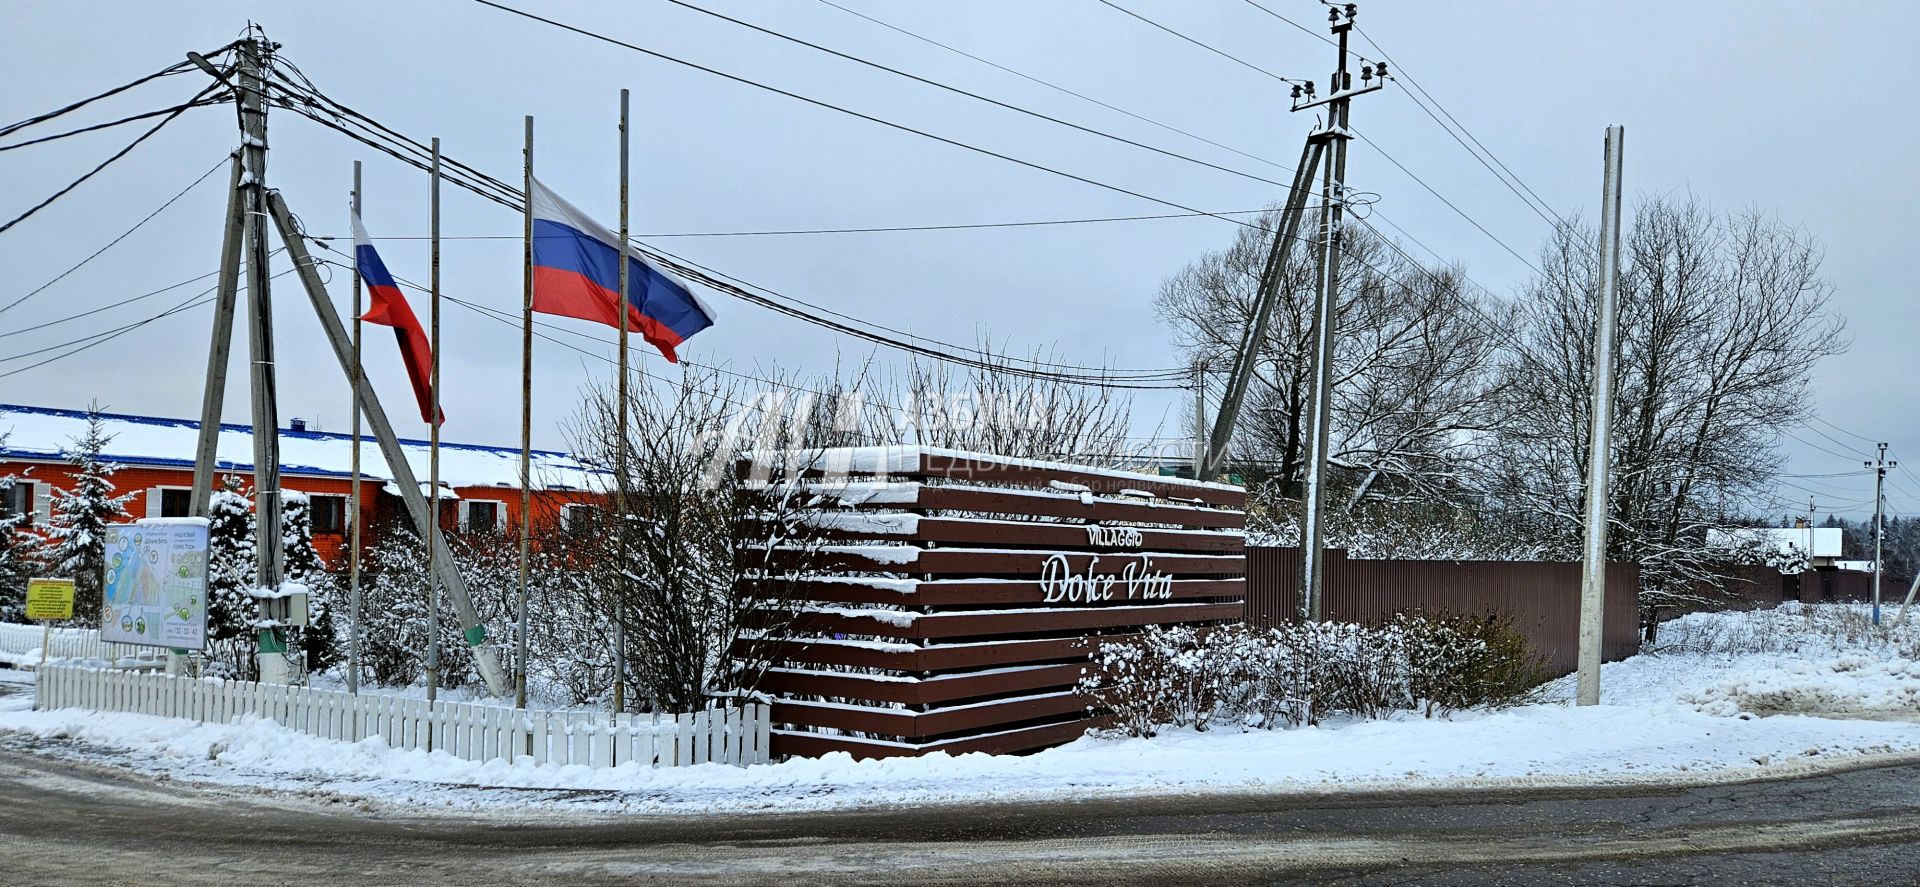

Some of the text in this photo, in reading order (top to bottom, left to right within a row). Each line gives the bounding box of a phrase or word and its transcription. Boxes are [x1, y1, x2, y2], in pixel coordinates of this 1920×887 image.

[1088, 530, 1143, 547] VILLAGGIO
[1039, 552, 1173, 604] Dolce Vita
